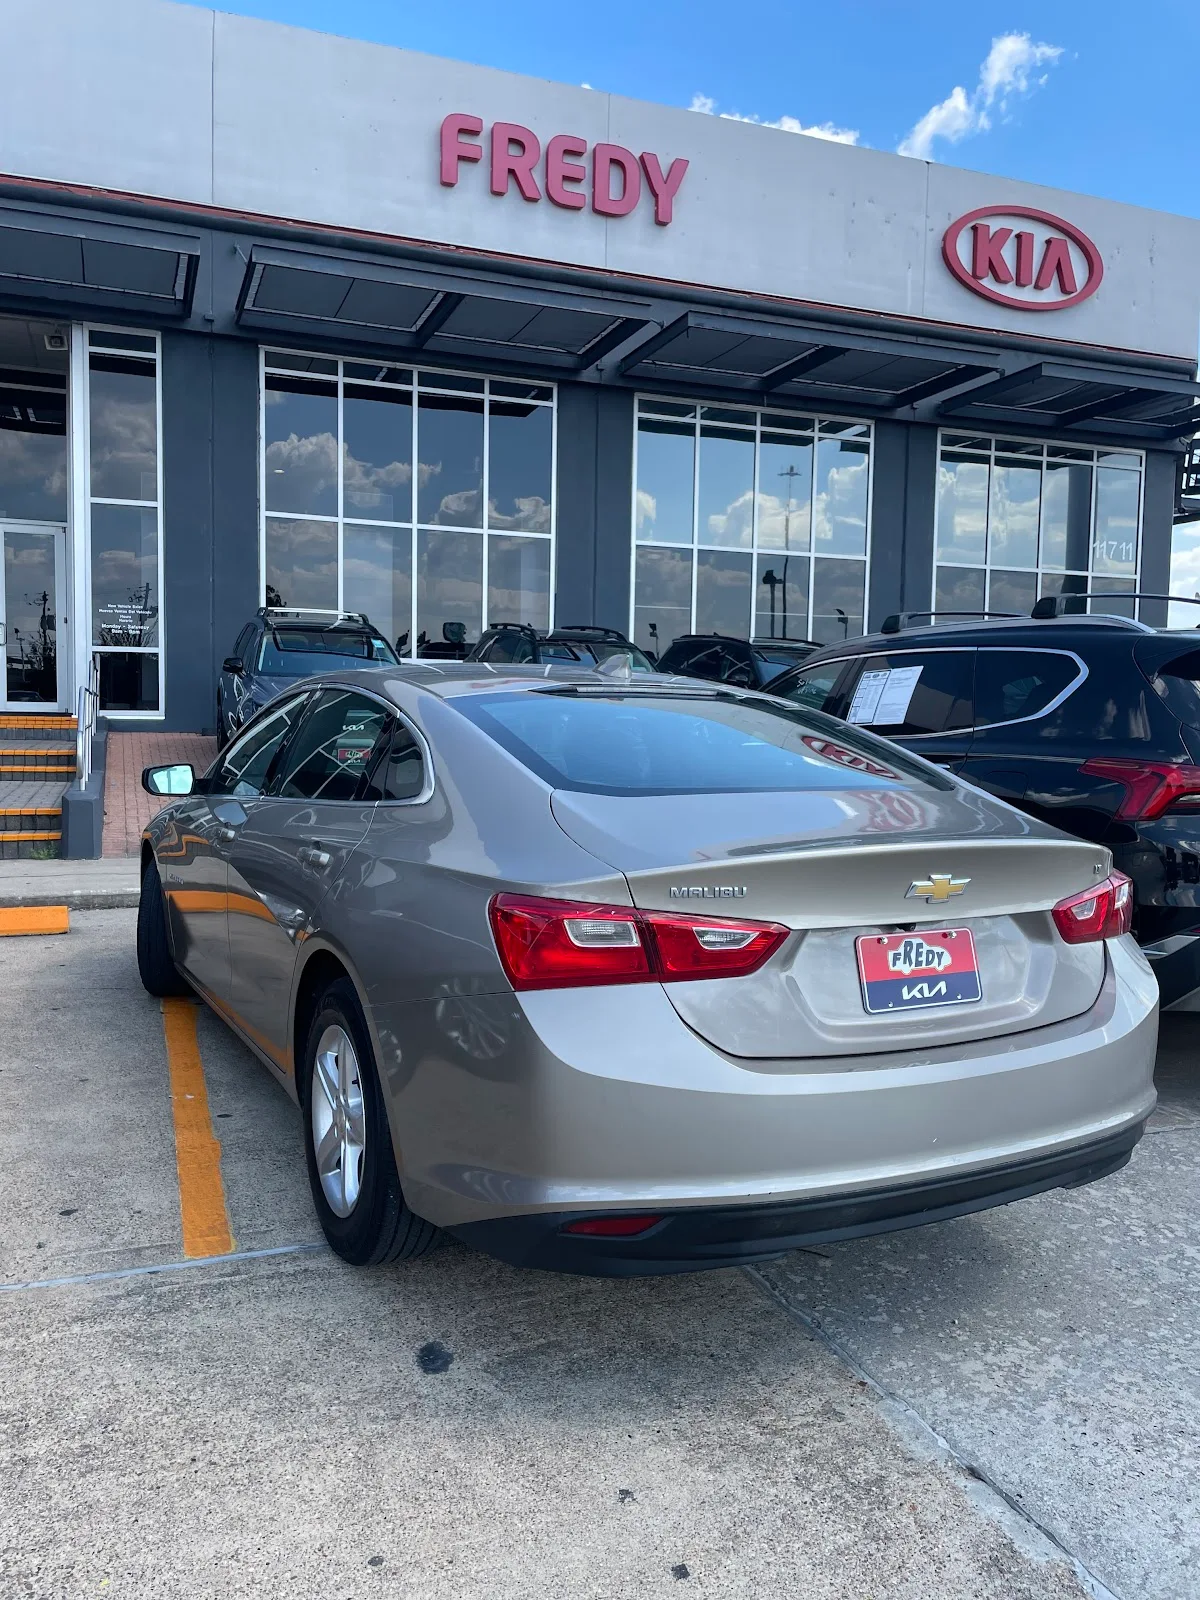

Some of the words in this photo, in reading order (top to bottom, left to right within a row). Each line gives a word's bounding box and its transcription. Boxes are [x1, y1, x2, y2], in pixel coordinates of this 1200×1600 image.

[440, 113, 690, 227] FREDY
[970, 222, 1078, 295] KIA
[1092, 540, 1133, 561] 11711
[670, 886, 747, 898] MALIBU
[892, 940, 945, 968] FREDY
[902, 980, 948, 1000] KIA
